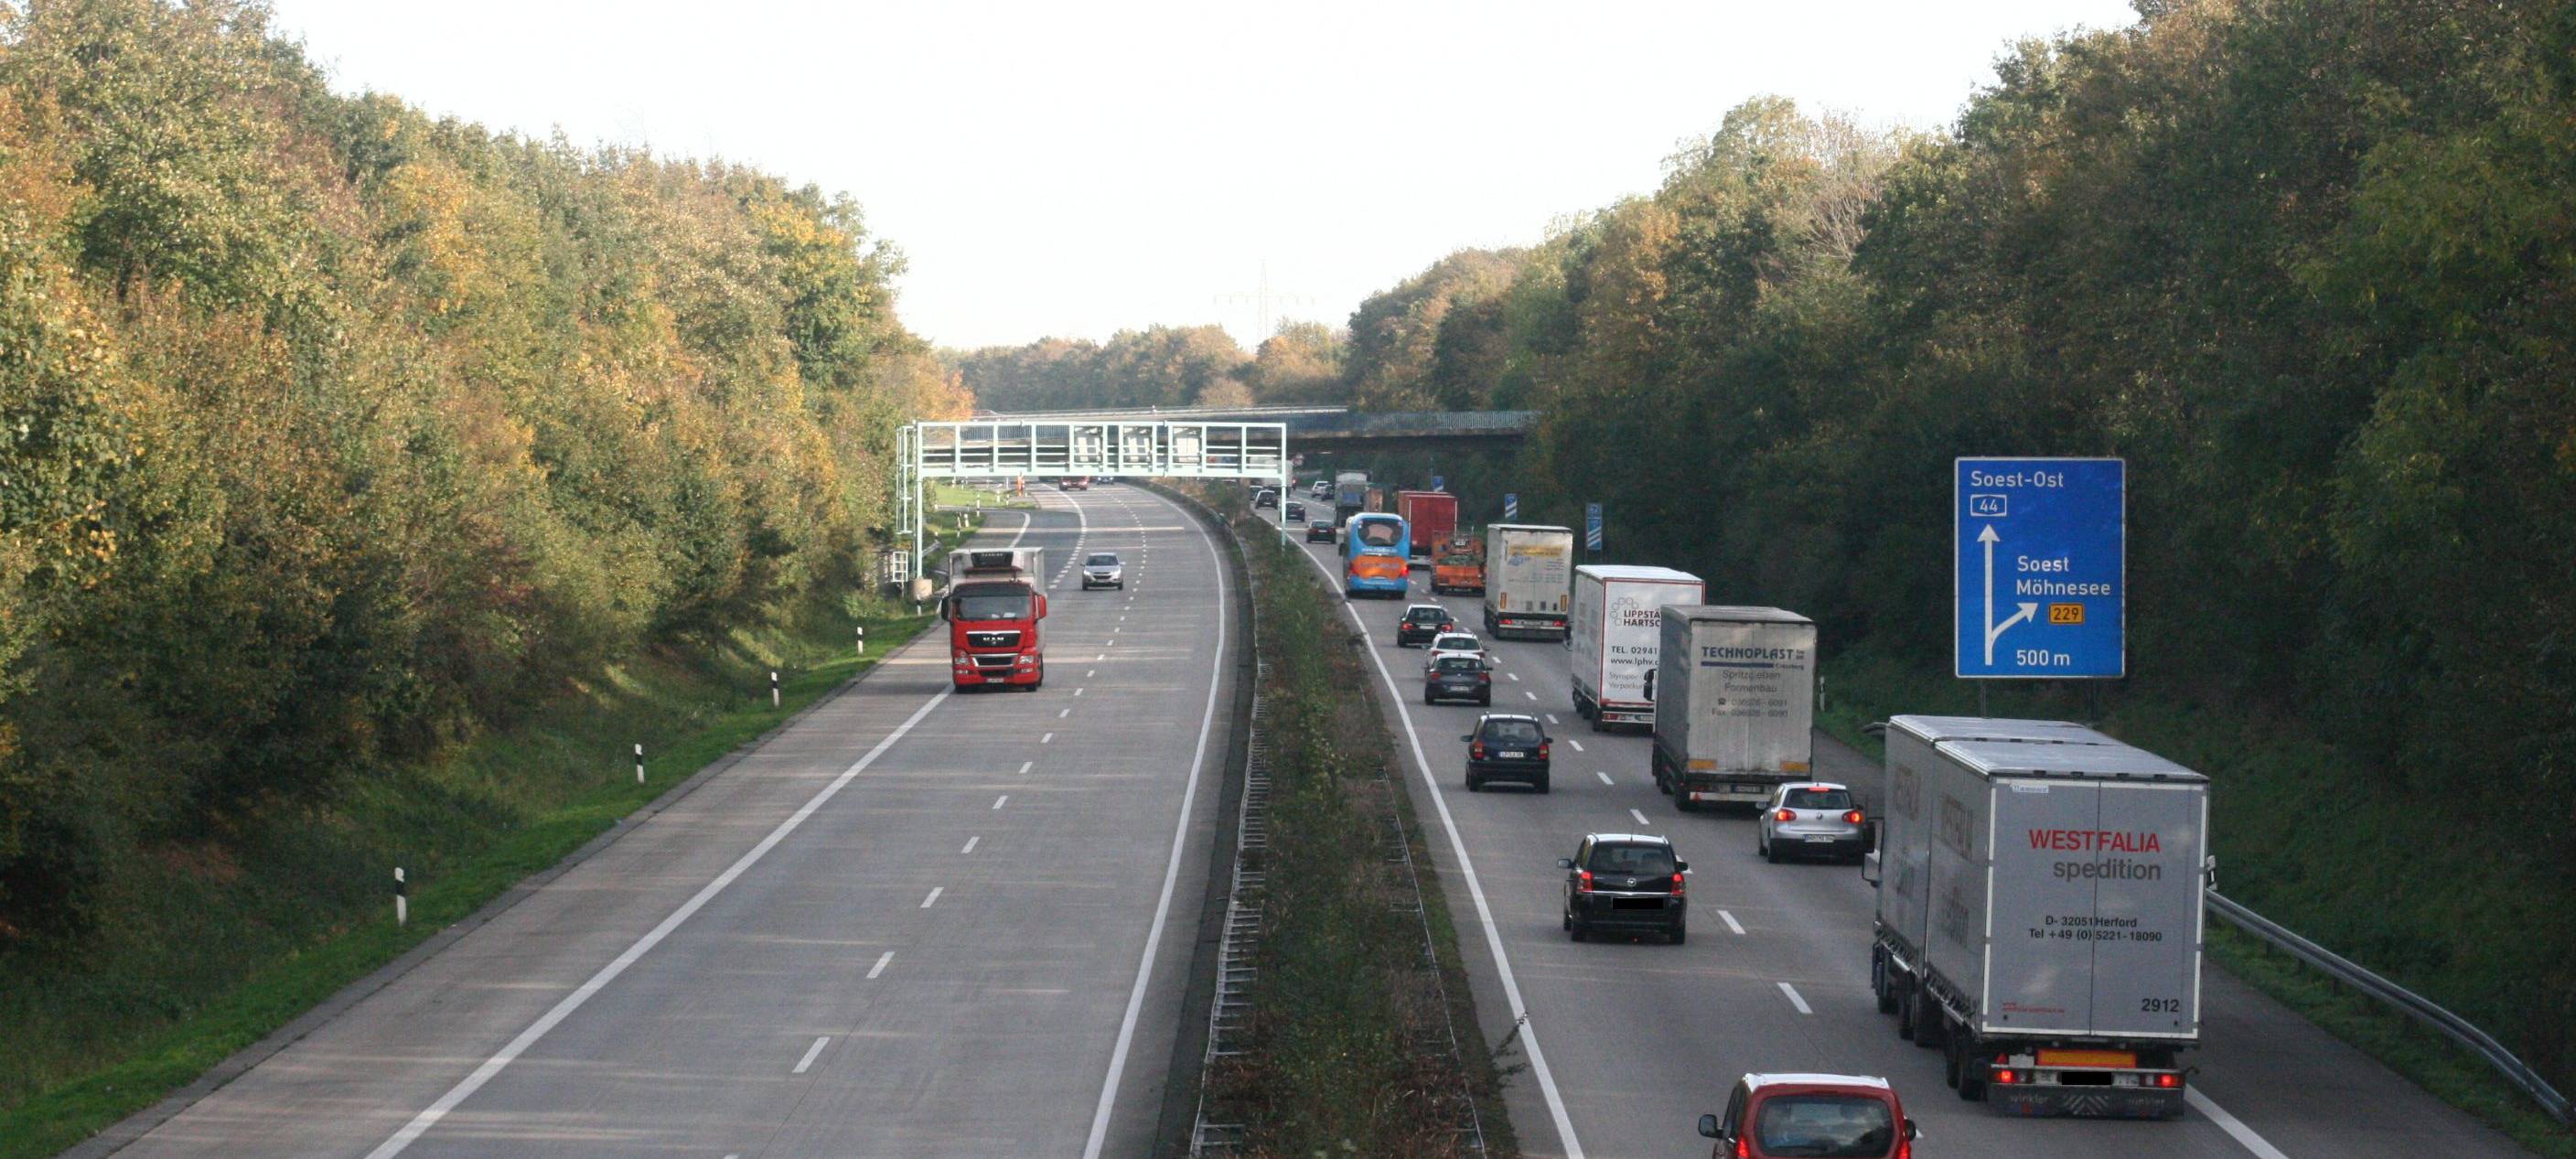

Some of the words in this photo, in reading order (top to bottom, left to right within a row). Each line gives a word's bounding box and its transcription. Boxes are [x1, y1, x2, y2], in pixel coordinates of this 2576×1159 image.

[1970, 470, 2064, 488] Soest-Ost
[1980, 499, 1998, 512] 44
[2017, 556, 2069, 572] Soest
[2016, 579, 2111, 596] Möhnesee
[2054, 607, 2079, 621] 229
[1631, 646, 1658, 655] 02941
[1701, 646, 1794, 660] TECHNOPLAST
[2016, 649, 2049, 666] 500
[2054, 654, 2070, 666] m
[2029, 829, 2161, 853] WESTFALIA
[2053, 858, 2162, 882] spedition
[2061, 916, 2093, 927] 32051
[2096, 917, 2138, 928] Herford
[2029, 928, 2044, 939] Tel
[2077, 928, 2091, 941] (0)
[2141, 998, 2180, 1013] 2912
